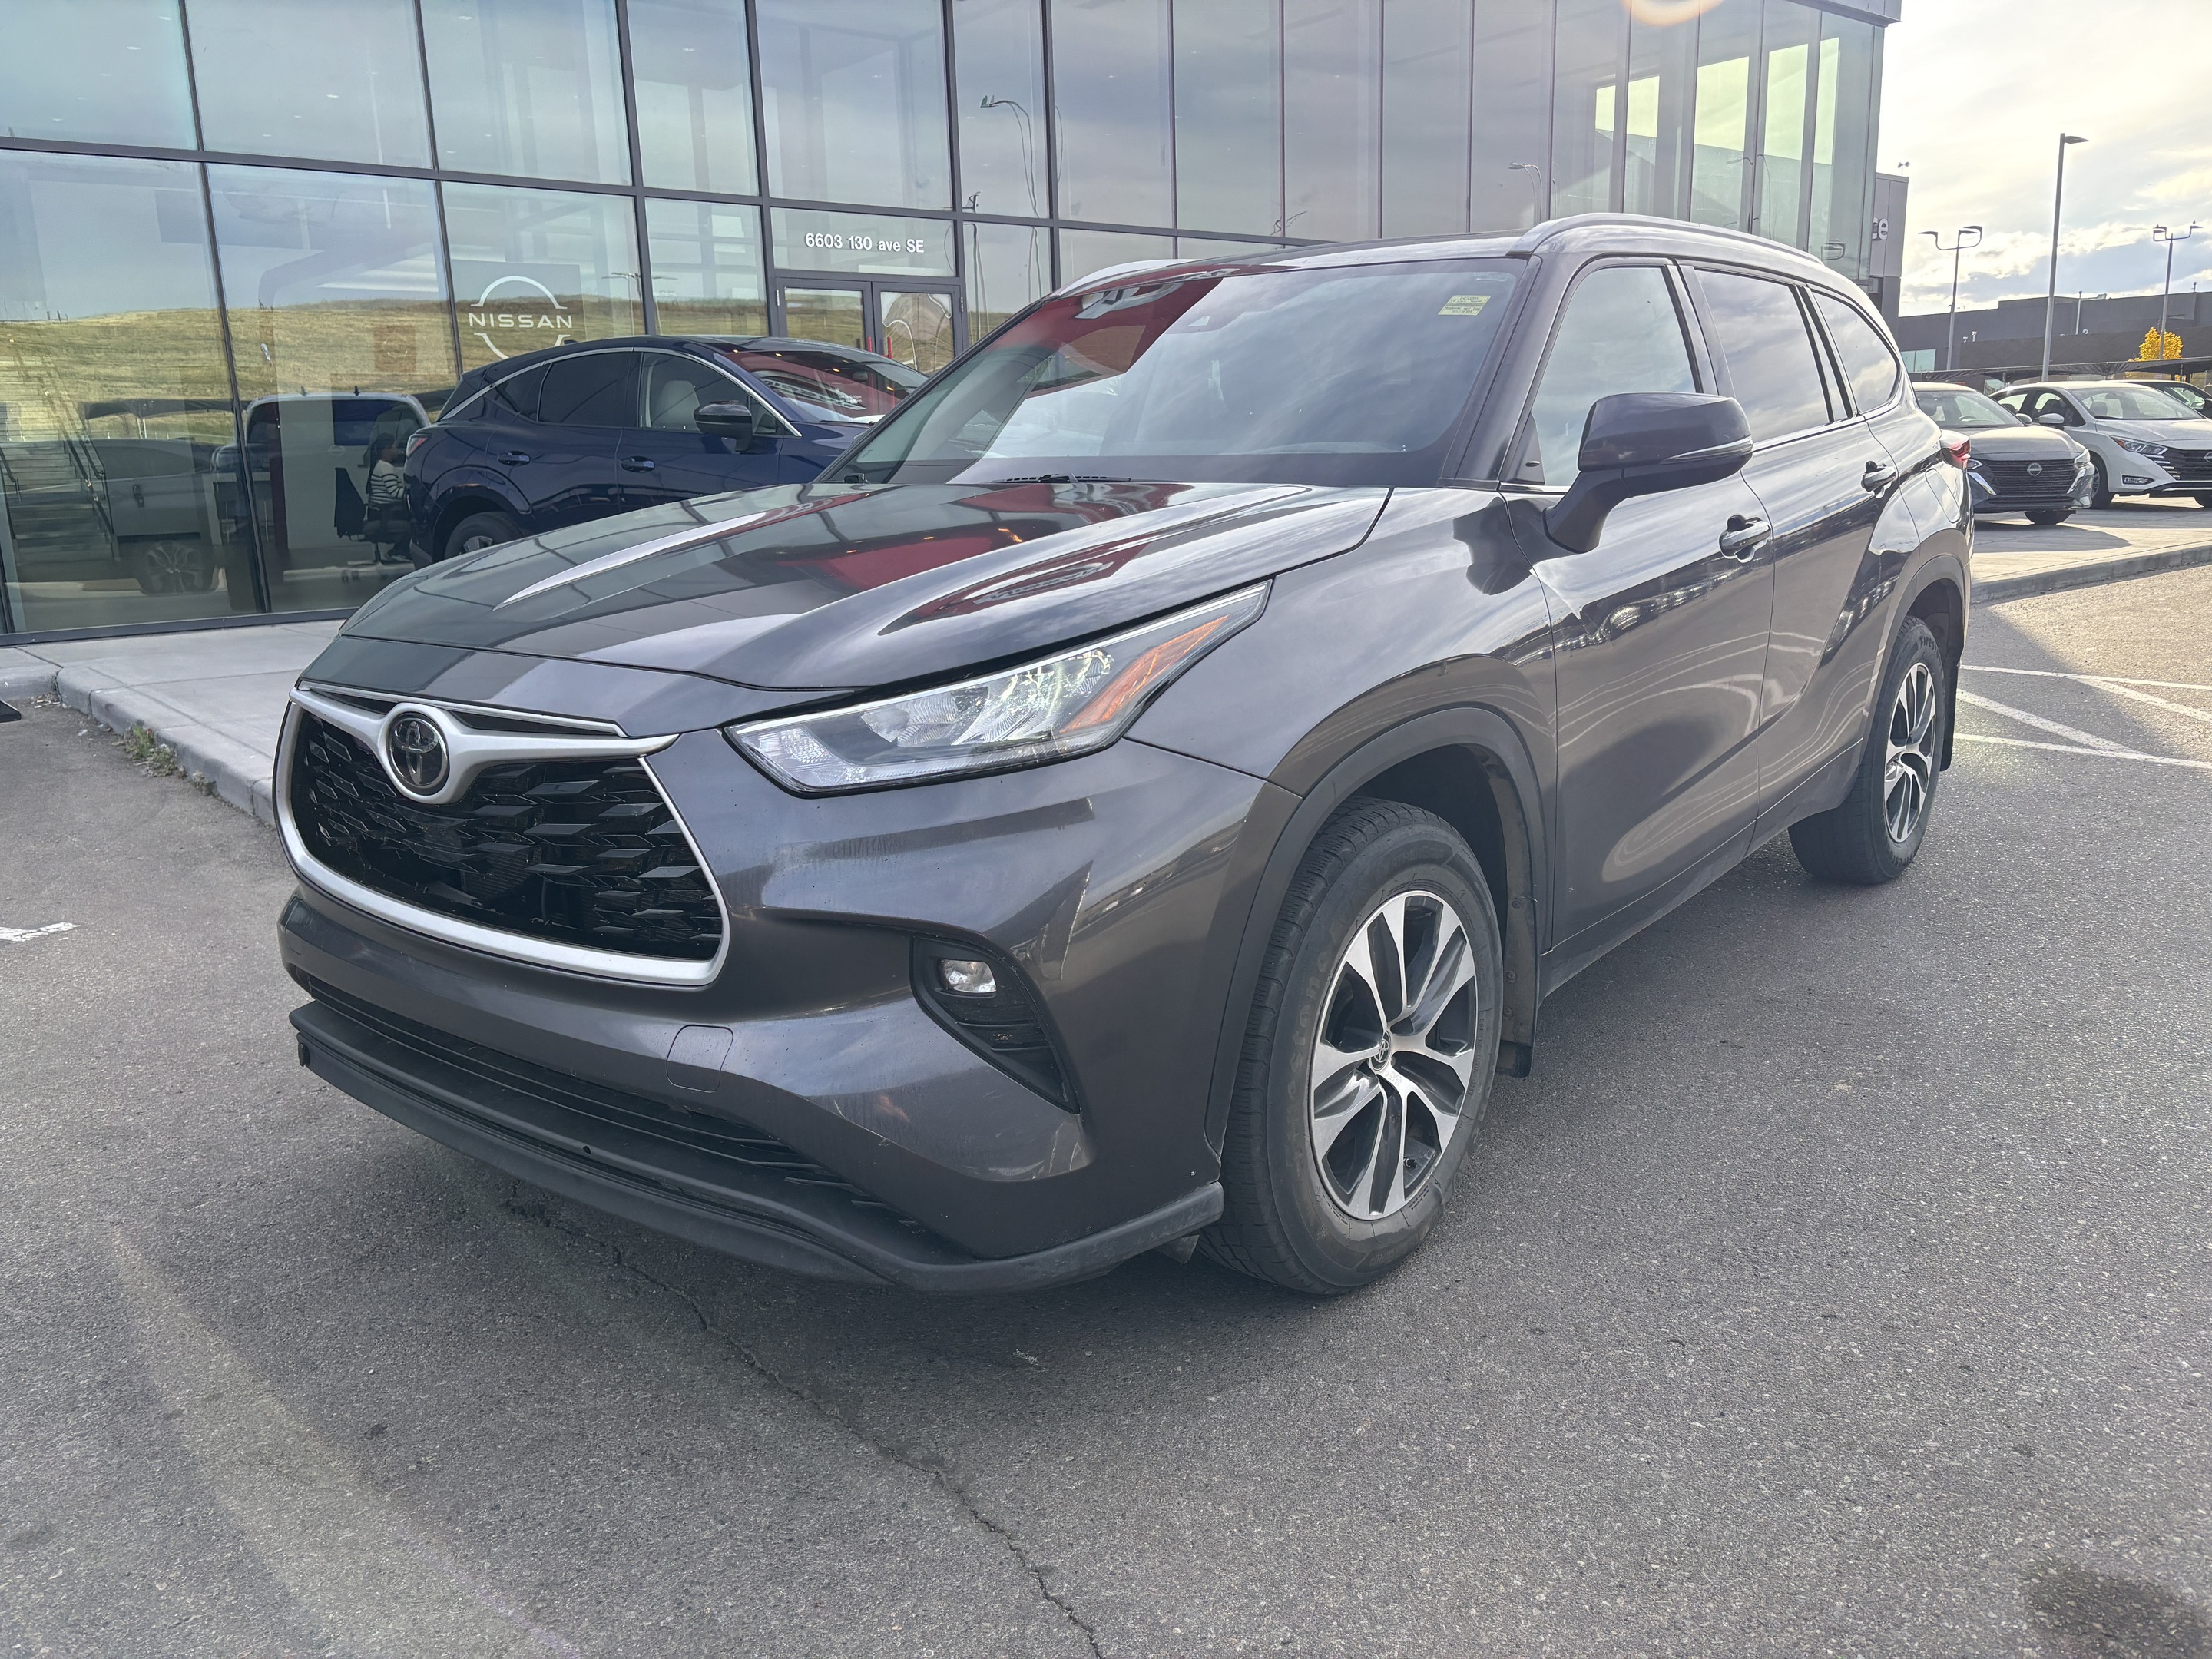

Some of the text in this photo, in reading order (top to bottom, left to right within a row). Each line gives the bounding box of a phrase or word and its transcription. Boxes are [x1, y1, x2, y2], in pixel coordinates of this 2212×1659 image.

[805, 233, 925, 253] 6603 130 ave SE
[468, 313, 573, 329] NISSAN
